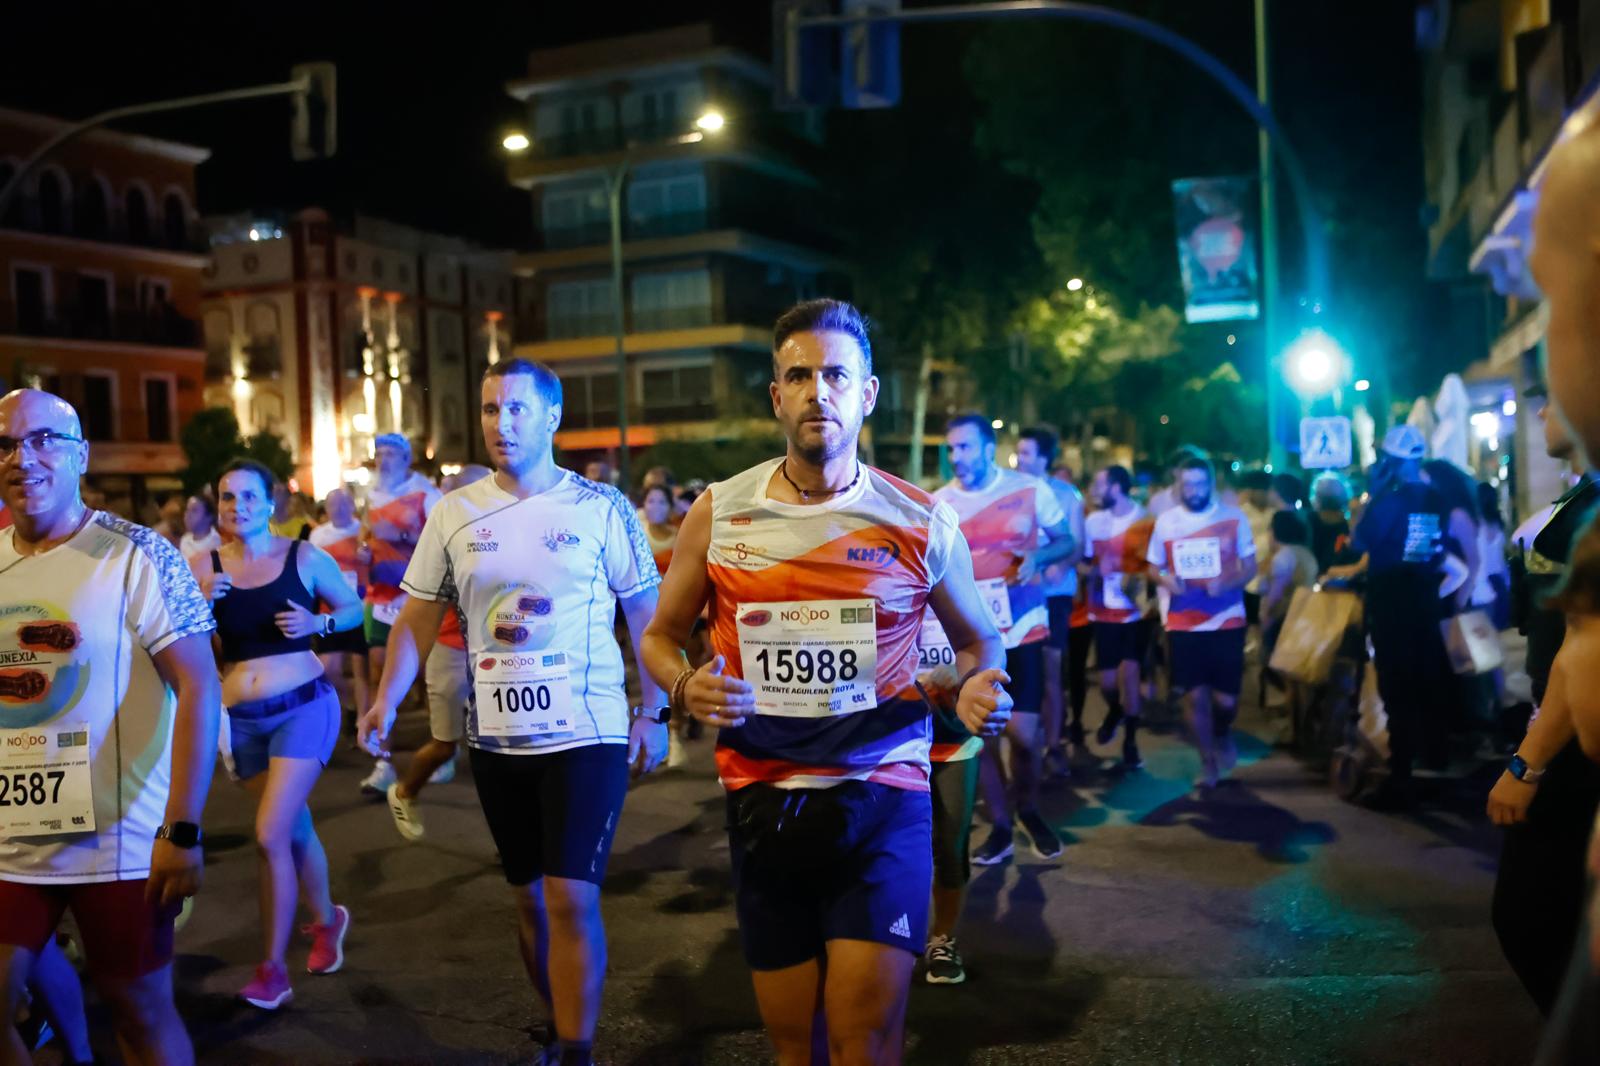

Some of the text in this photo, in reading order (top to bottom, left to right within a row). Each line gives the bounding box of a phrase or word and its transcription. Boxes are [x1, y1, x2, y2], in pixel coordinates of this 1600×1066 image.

[756, 648, 858, 684] 15988
[493, 685, 551, 713] 1000
[761, 683, 855, 695] VICENTE AGUILERA TROYA
[0, 771, 65, 806] 2587
